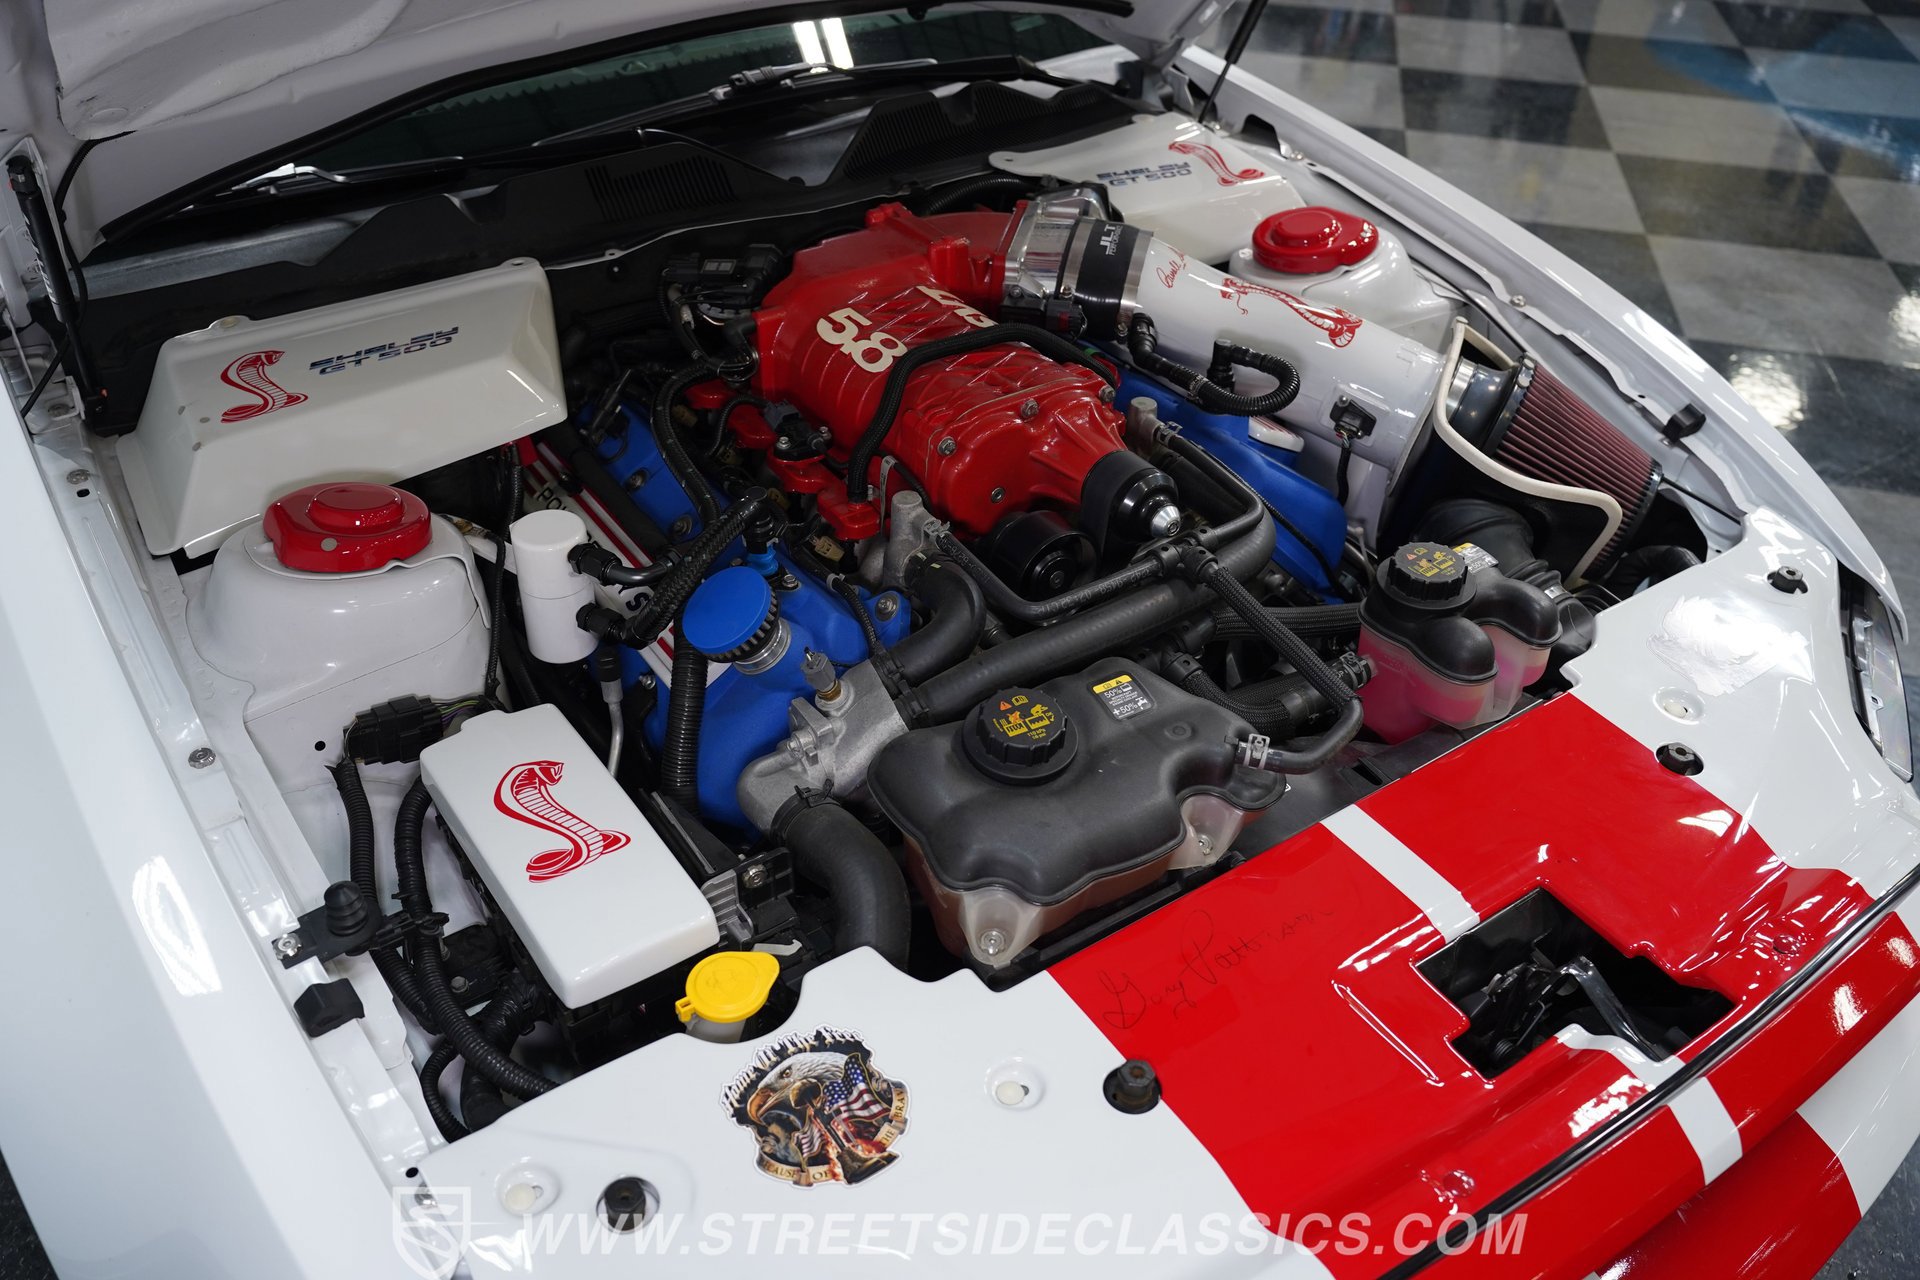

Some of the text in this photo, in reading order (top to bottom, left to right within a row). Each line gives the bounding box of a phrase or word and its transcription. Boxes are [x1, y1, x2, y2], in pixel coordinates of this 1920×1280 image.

[1096, 161, 1191, 181] SHELBY
[1100, 224, 1116, 255] JLT
[309, 326, 460, 370] SHELBY
[721, 1065, 760, 1115] Home
[777, 1032, 820, 1056] The
[819, 1026, 865, 1048] Free
